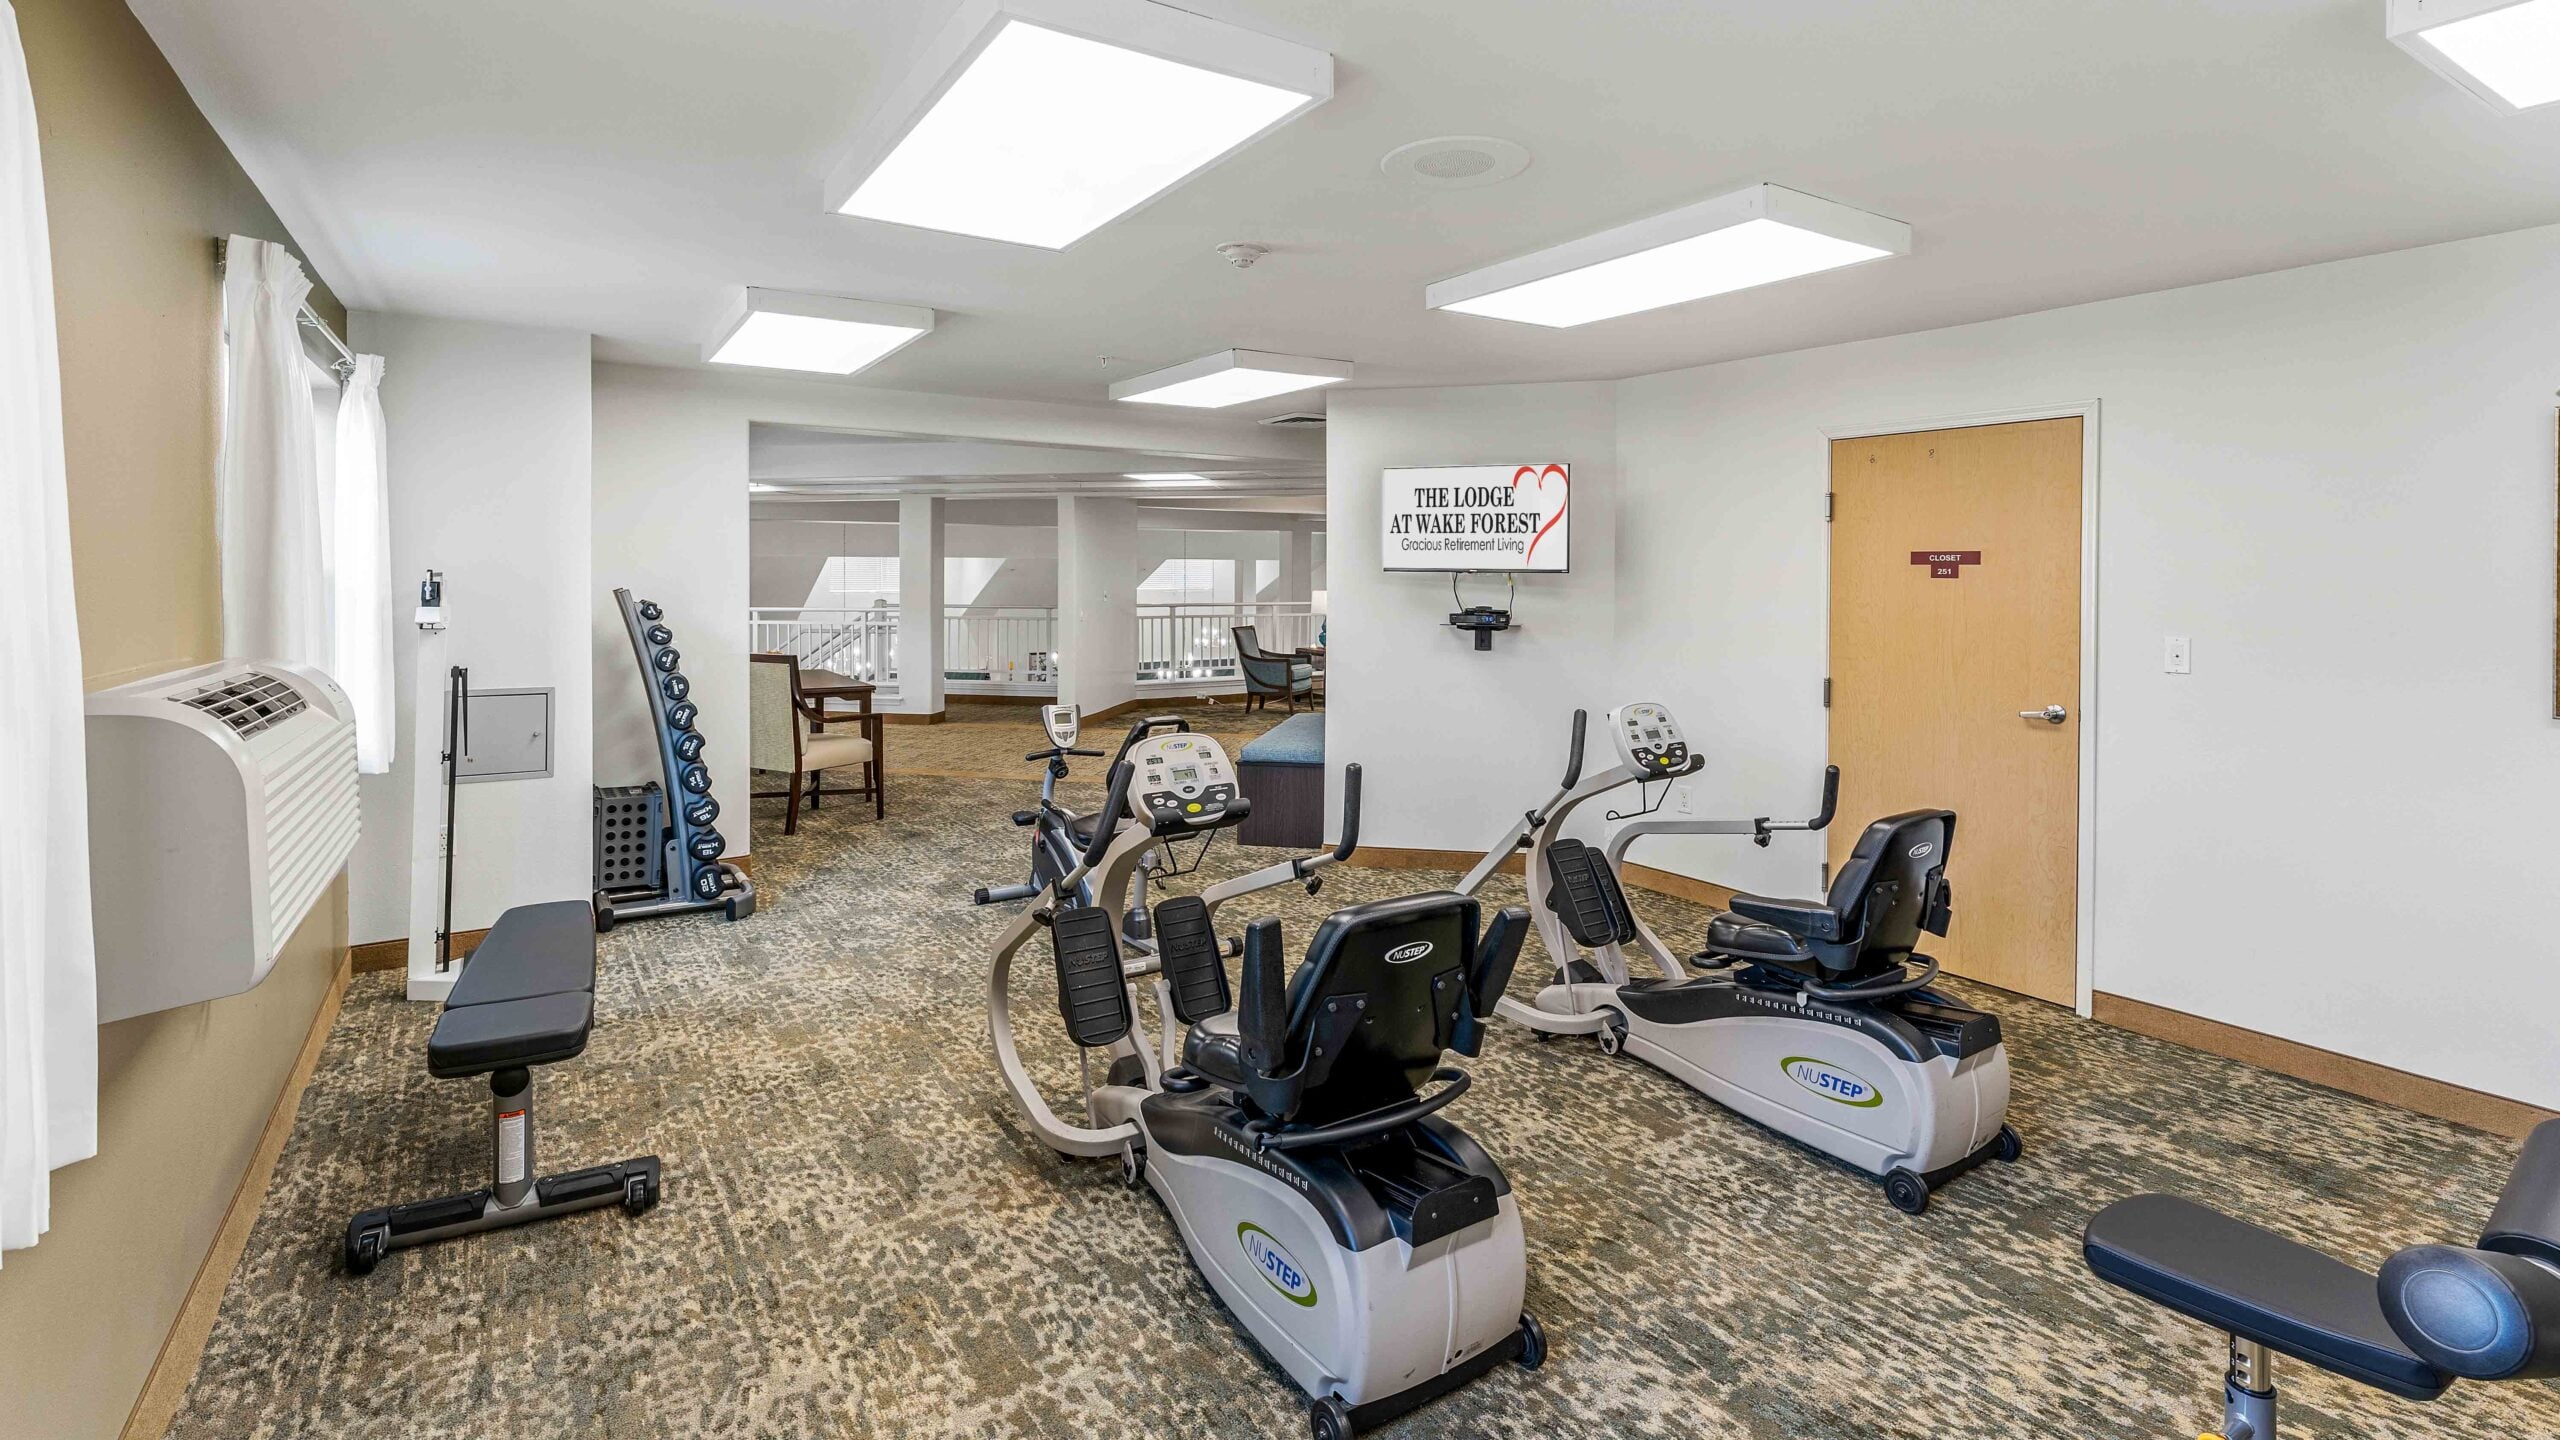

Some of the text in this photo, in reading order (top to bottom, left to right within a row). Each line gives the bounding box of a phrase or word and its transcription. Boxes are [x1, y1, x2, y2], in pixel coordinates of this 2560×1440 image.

[1414, 486, 1514, 508] THE LODGE
[1390, 512, 1540, 534] AT WAKE FOREST
[1401, 537, 1524, 554] Gracious Retirement Living
[1929, 554, 1961, 562] CLOSET
[700, 878, 709, 892] 20
[1392, 945, 1427, 960] NUSTEP
[1797, 1064, 1864, 1098] NUSTEP
[1249, 1234, 1302, 1290] NUSTEP
